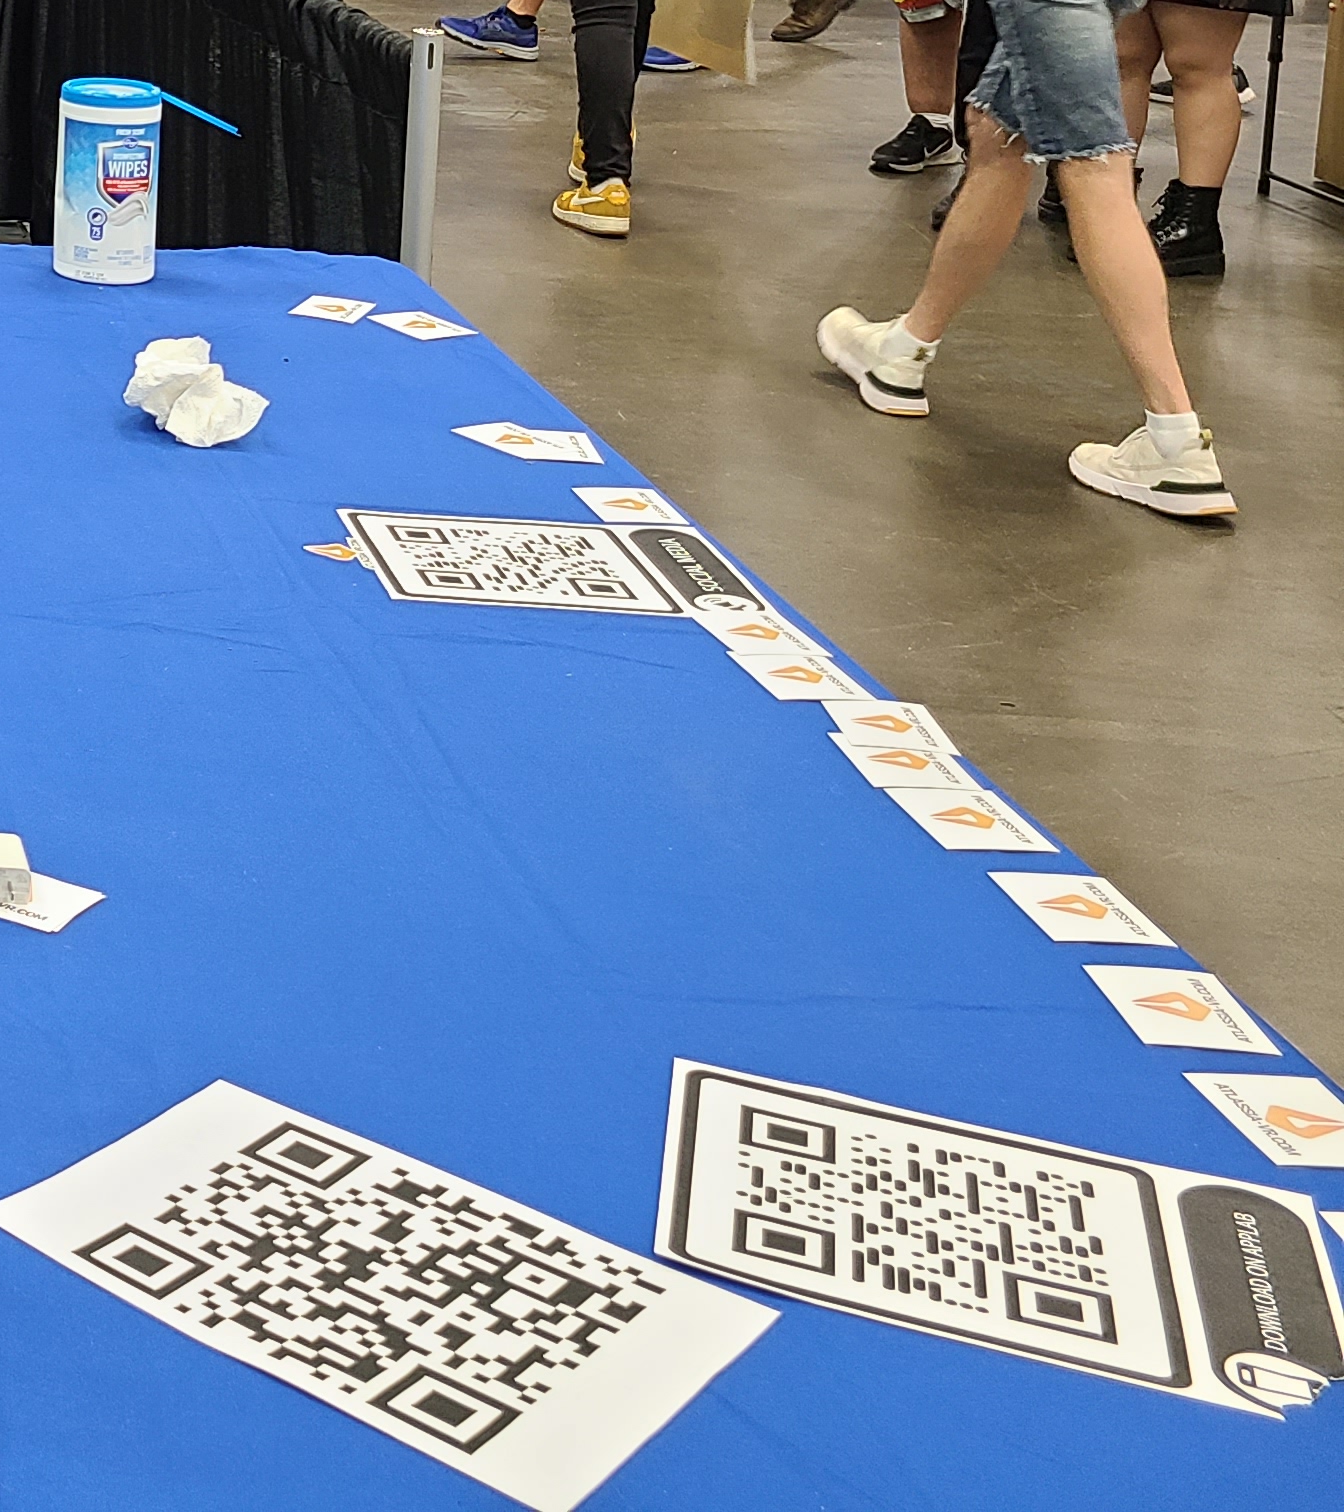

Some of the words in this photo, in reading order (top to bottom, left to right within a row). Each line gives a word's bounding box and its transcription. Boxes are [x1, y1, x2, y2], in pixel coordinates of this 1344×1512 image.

[108, 159, 148, 178] WIPES
[658, 537, 697, 569] MEDIA
[684, 566, 724, 593] SOCIAL
[1083, 881, 1150, 938] ATLASSIA-VR.COM
[1186, 977, 1254, 1044] ATLASSIA-VR.COM
[1213, 1081, 1302, 1157] ATLASSIA-VR.COM
[1233, 1211, 1265, 1259] APPLAB
[1243, 1255, 1269, 1277] ON
[1249, 1278, 1288, 1354] DOWNLOAD
